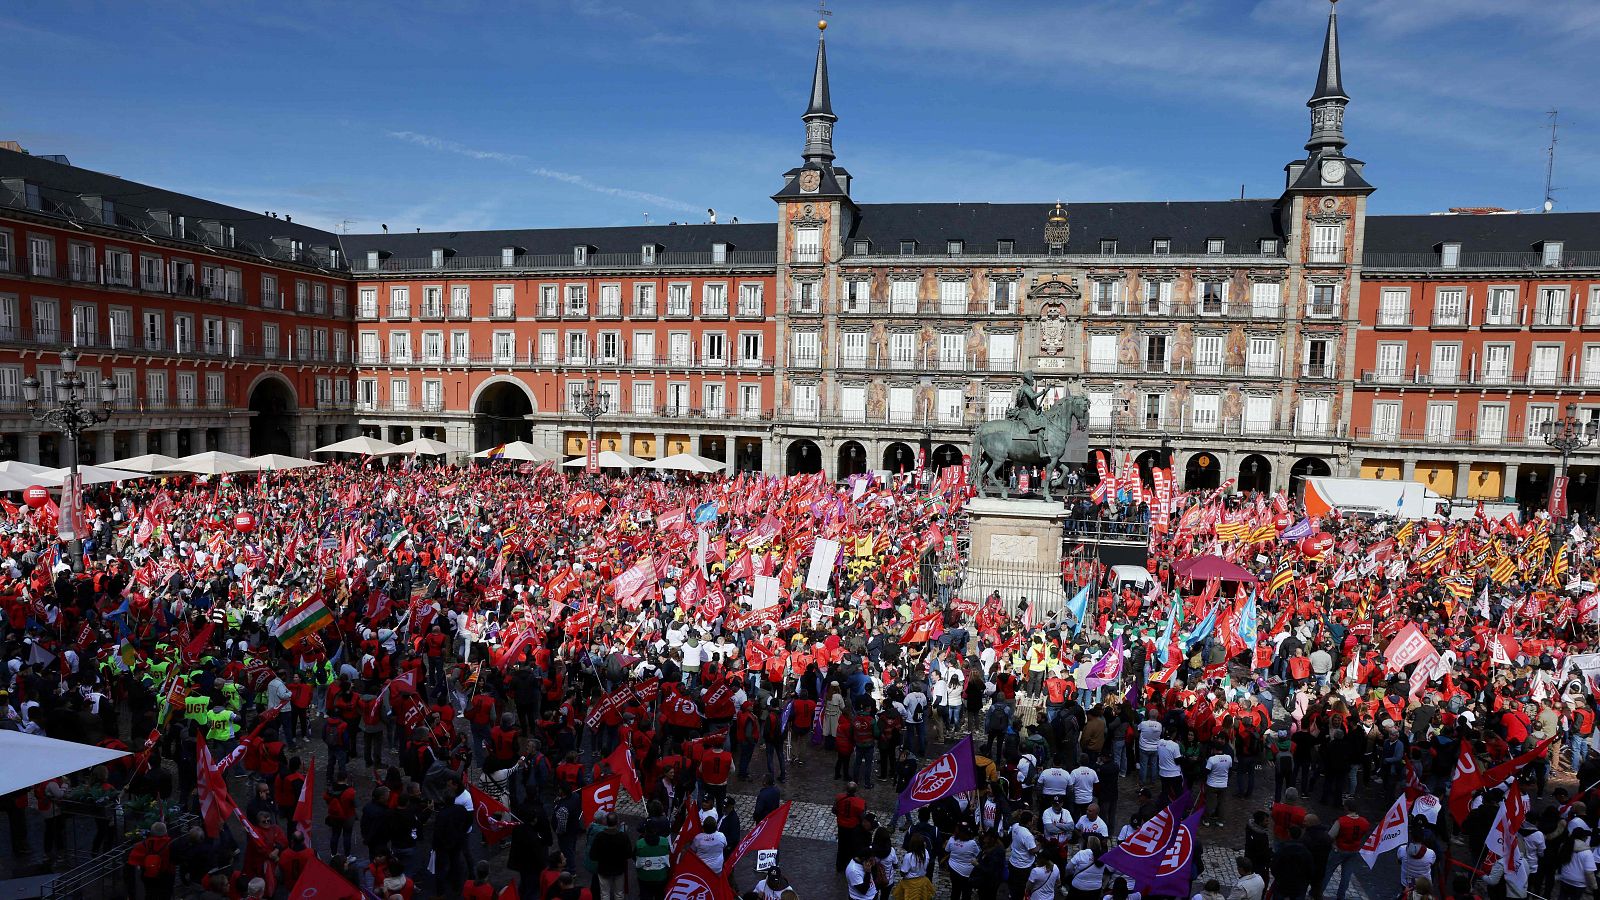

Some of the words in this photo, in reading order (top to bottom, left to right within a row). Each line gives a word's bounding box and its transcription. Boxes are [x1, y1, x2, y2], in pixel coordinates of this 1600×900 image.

[1554, 478, 1565, 509] UGT
[186, 703, 206, 715] UGT
[1130, 809, 1169, 854] UGT
